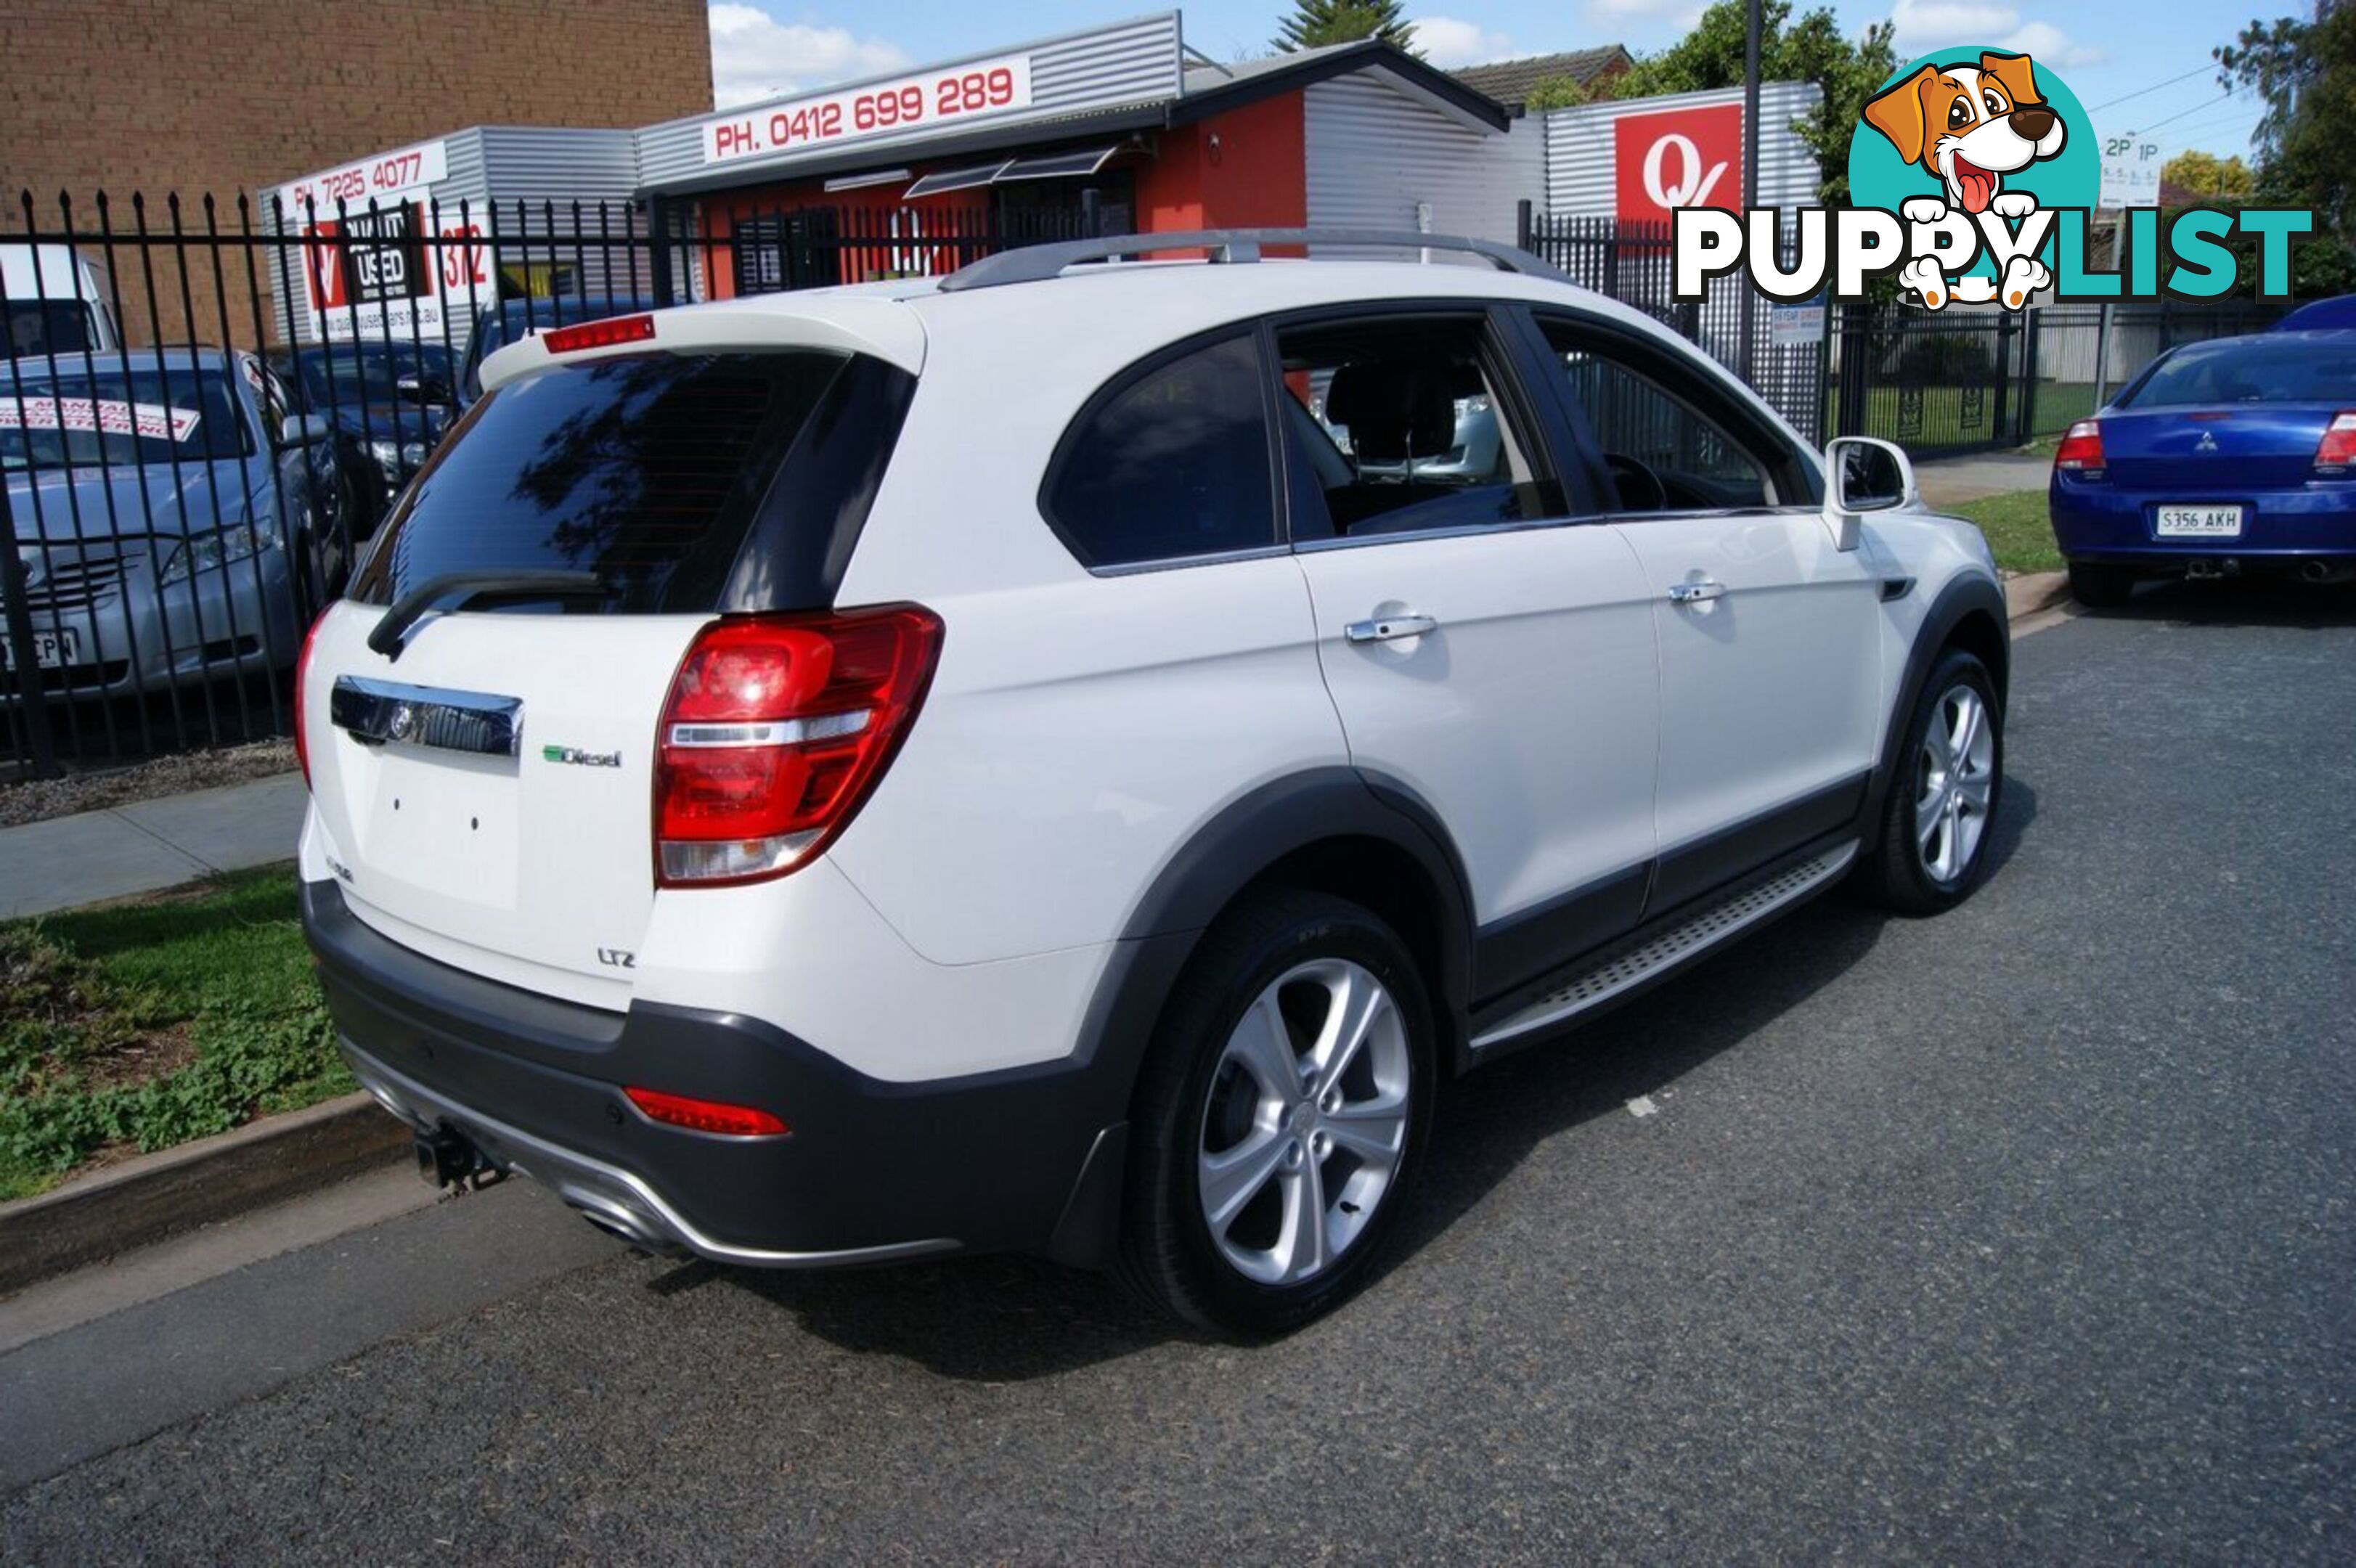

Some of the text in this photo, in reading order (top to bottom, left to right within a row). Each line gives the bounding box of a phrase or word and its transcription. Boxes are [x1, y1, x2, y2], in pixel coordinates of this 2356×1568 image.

[716, 68, 1014, 157] PH. 0412 699 289
[2106, 139, 2131, 156] 2P
[321, 168, 365, 203] 7225
[373, 152, 422, 190] 4077
[357, 249, 404, 287] USED
[441, 224, 487, 288] 372
[2163, 513, 2236, 527] S356 AKH
[561, 747, 622, 768] Diesel
[597, 947, 636, 968] LTZ
